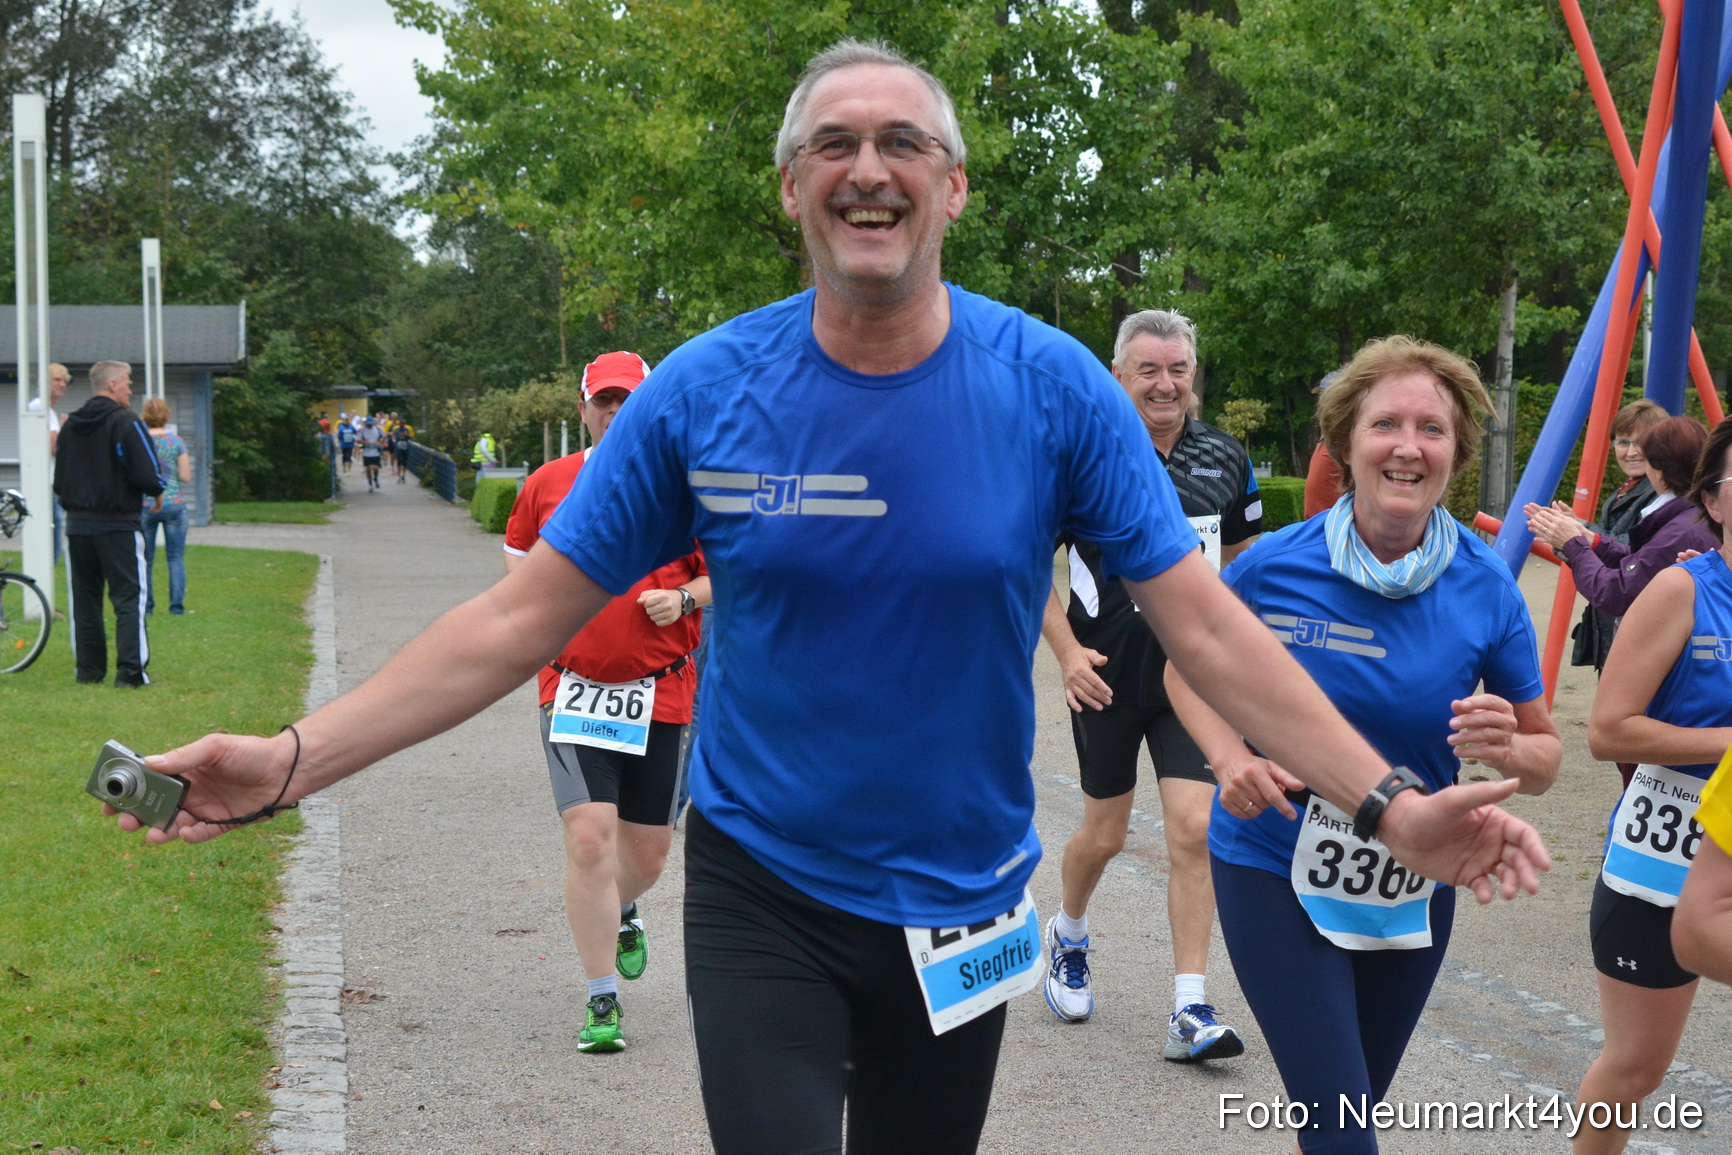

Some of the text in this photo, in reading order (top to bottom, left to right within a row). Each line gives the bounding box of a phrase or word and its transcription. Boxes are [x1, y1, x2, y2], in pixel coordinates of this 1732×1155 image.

[1190, 467, 1223, 478] DONIC
[1195, 525, 1208, 534] rkt
[564, 682, 645, 721] 2756
[581, 720, 619, 738] Dieter
[1633, 771, 1702, 805] PARTL Neu
[1624, 795, 1705, 862] 338
[919, 951, 930, 964] D
[959, 938, 1033, 991] Siegfrie
